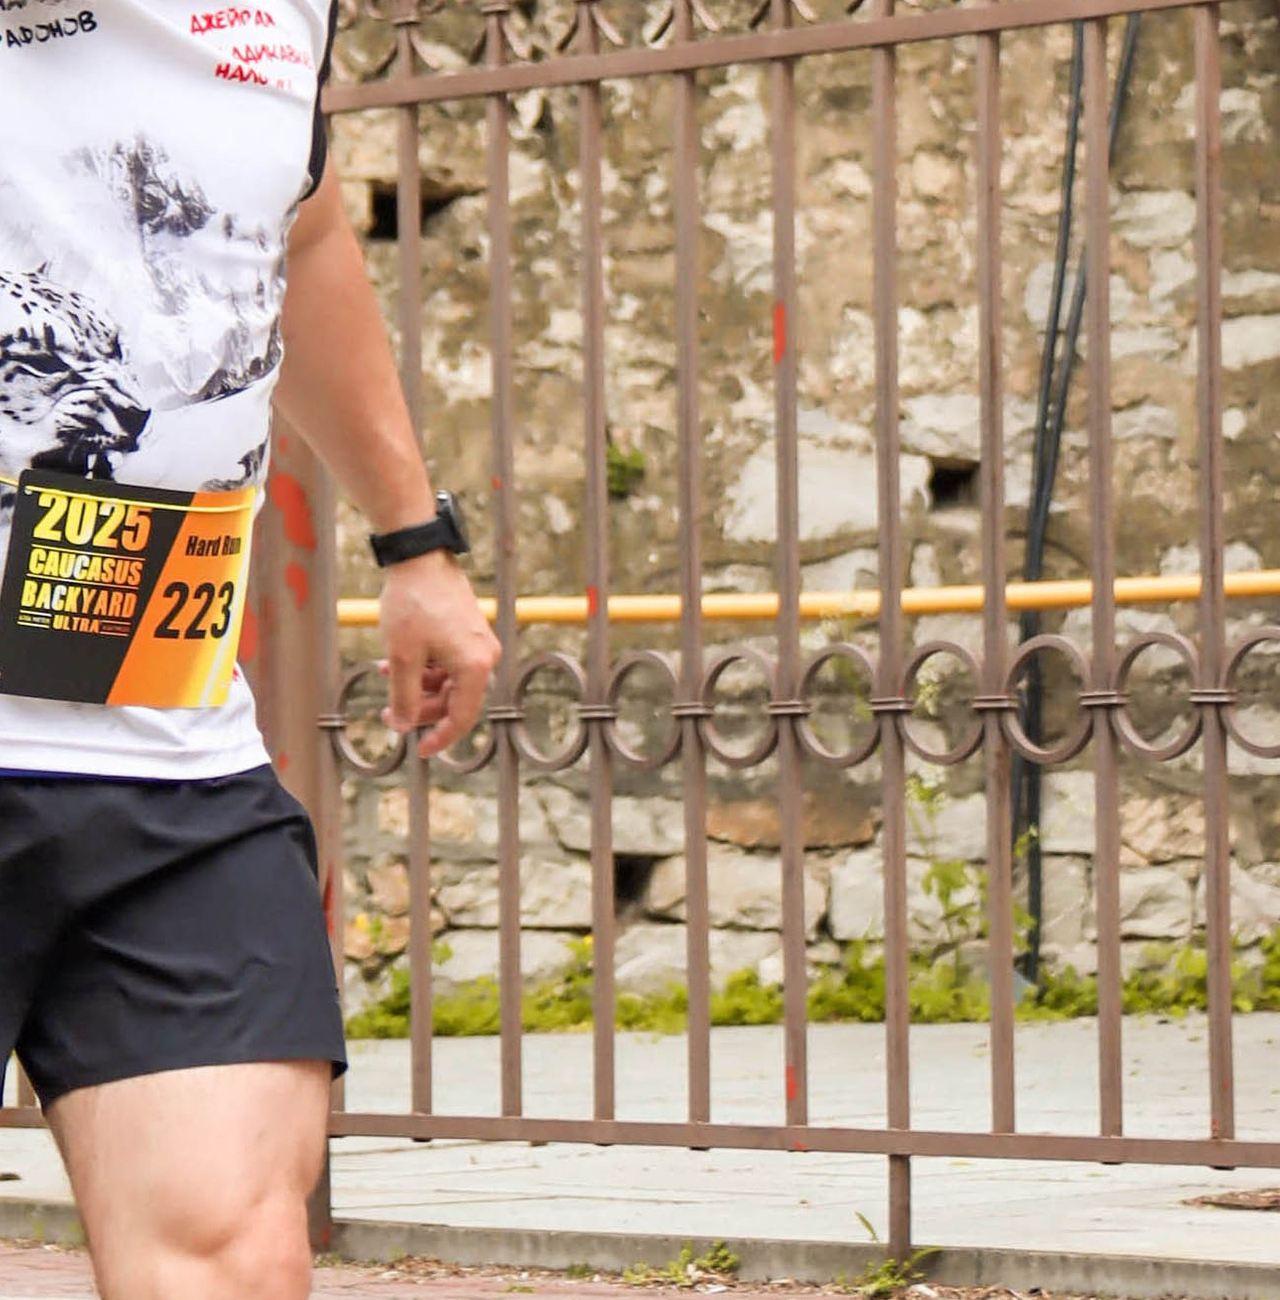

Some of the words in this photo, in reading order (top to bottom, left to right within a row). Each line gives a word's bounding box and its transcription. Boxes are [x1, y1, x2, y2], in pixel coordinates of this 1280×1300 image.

[33, 492, 152, 551] 2025
[186, 535, 221, 557] Hard
[222, 535, 241, 556] Run
[28, 548, 142, 586] CAUCASUS
[21, 579, 137, 618] BACKYARD
[154, 581, 235, 639] 223
[52, 614, 100, 634] ULTRA
